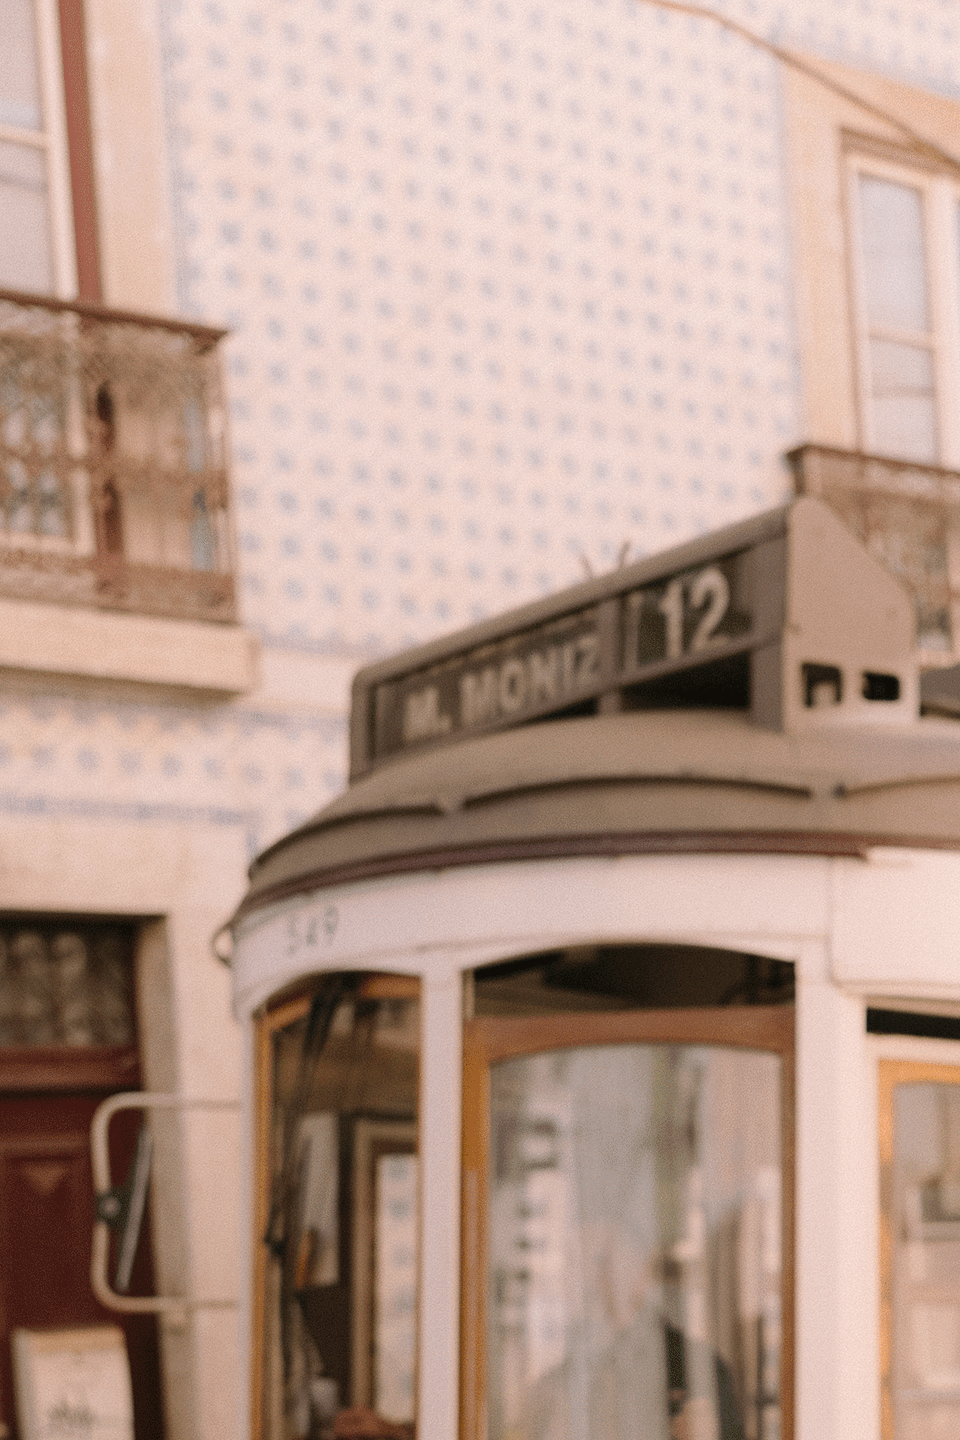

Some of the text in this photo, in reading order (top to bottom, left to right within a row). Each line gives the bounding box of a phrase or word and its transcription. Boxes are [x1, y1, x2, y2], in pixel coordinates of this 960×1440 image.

[658, 567, 732, 660] 12
[404, 636, 601, 738] M. MONIZ
